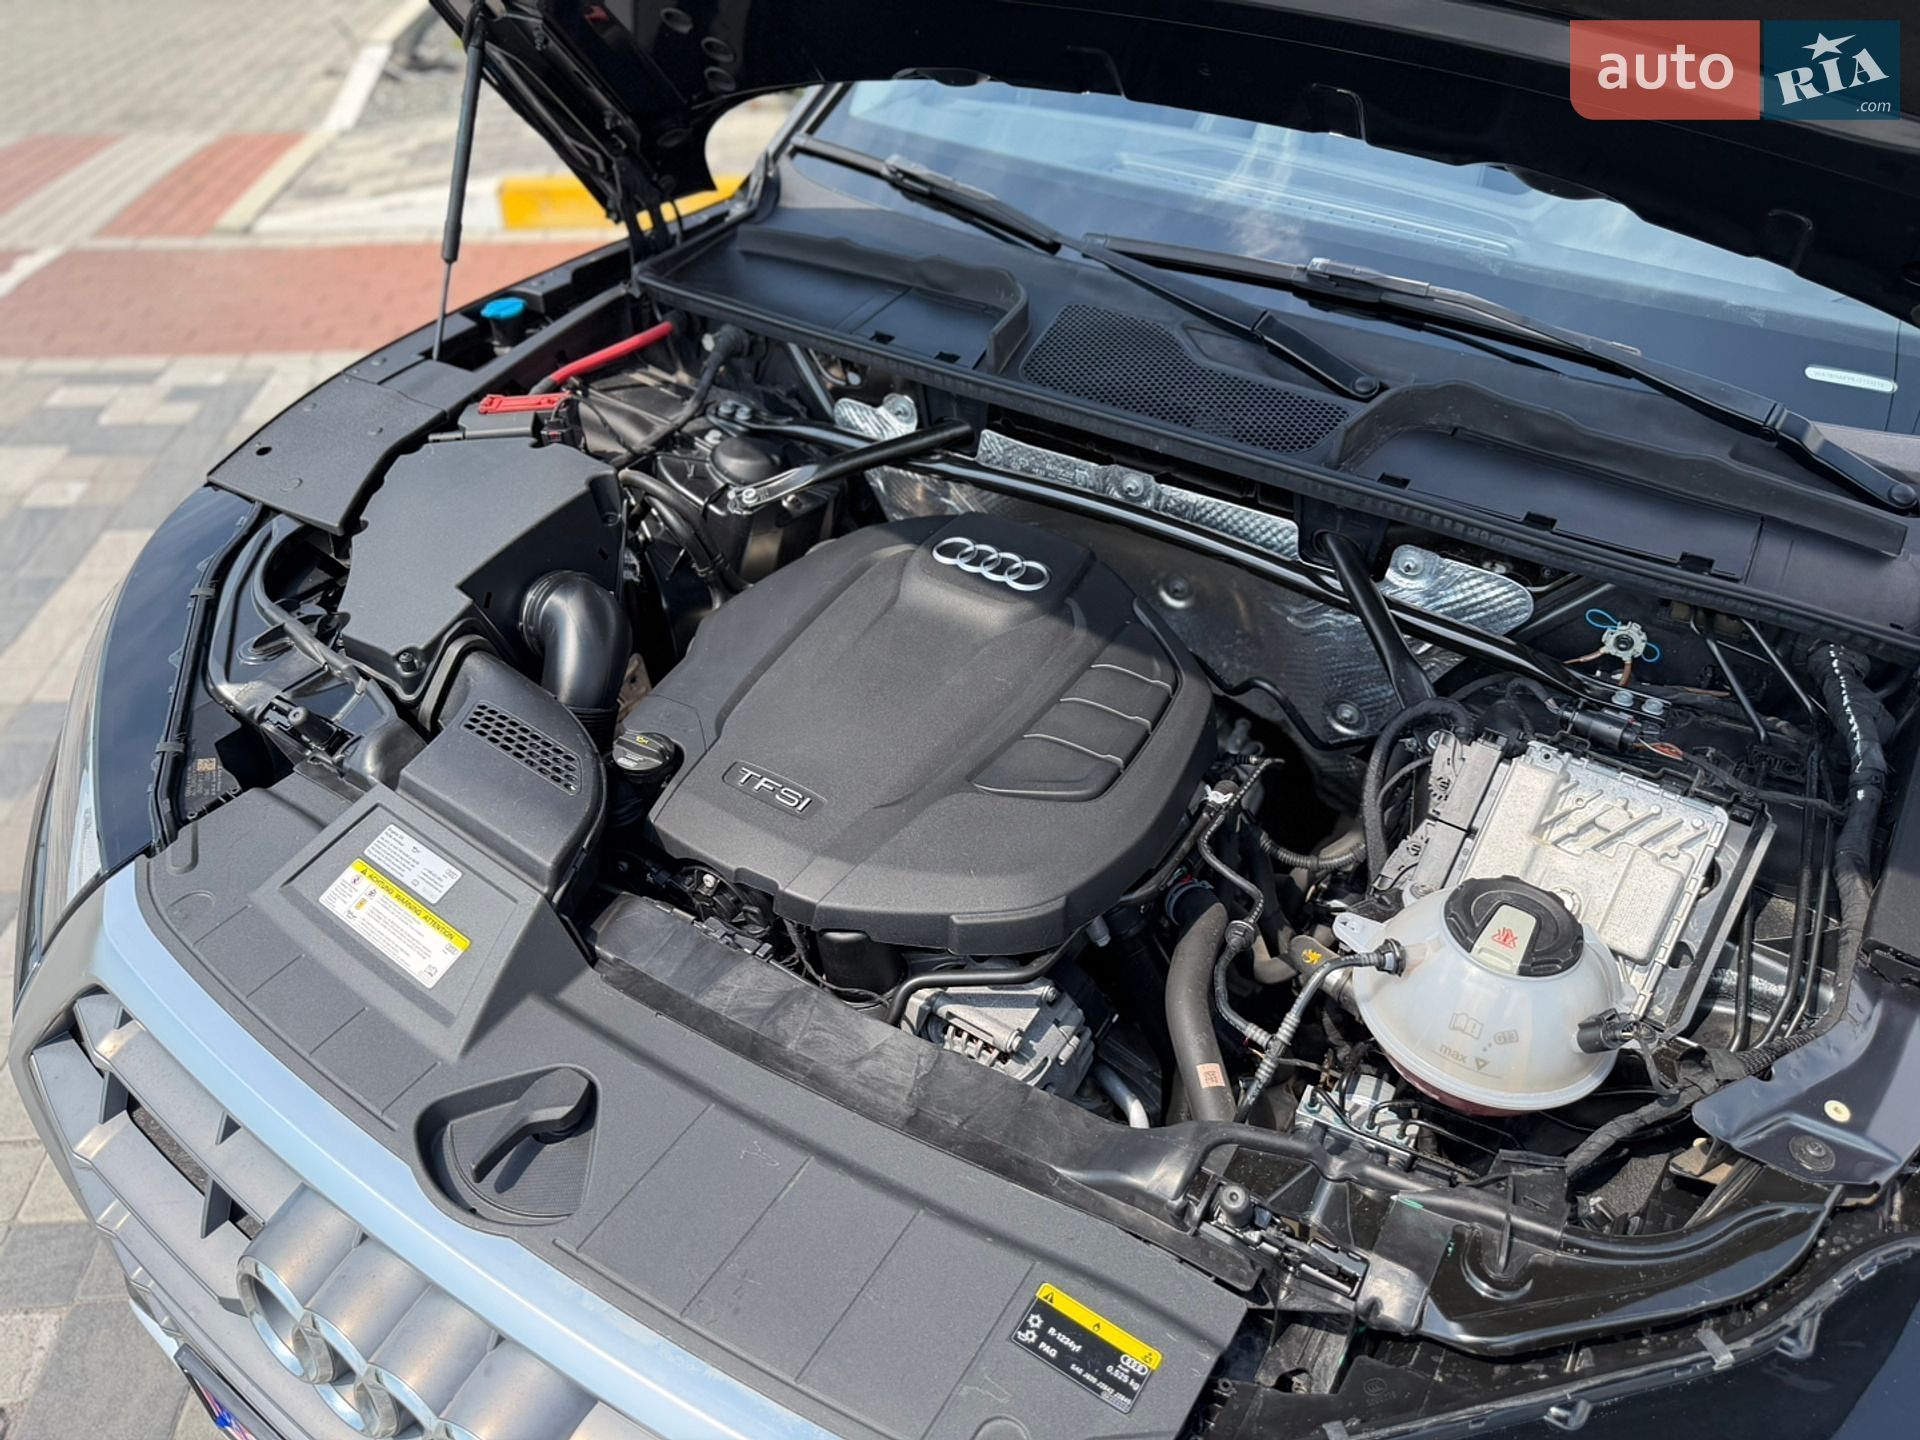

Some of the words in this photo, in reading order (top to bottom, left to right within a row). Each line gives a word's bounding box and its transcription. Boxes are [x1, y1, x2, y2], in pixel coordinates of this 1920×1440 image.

[739, 767, 811, 812] TFSI
[369, 872, 394, 896] ACHTUNG
[395, 894, 422, 917] WARNING
[423, 912, 456, 940] ATTENTION
[1439, 1043, 1467, 1064] max
[1038, 1341, 1058, 1358] PAG
[1129, 1378, 1140, 1391] kg
